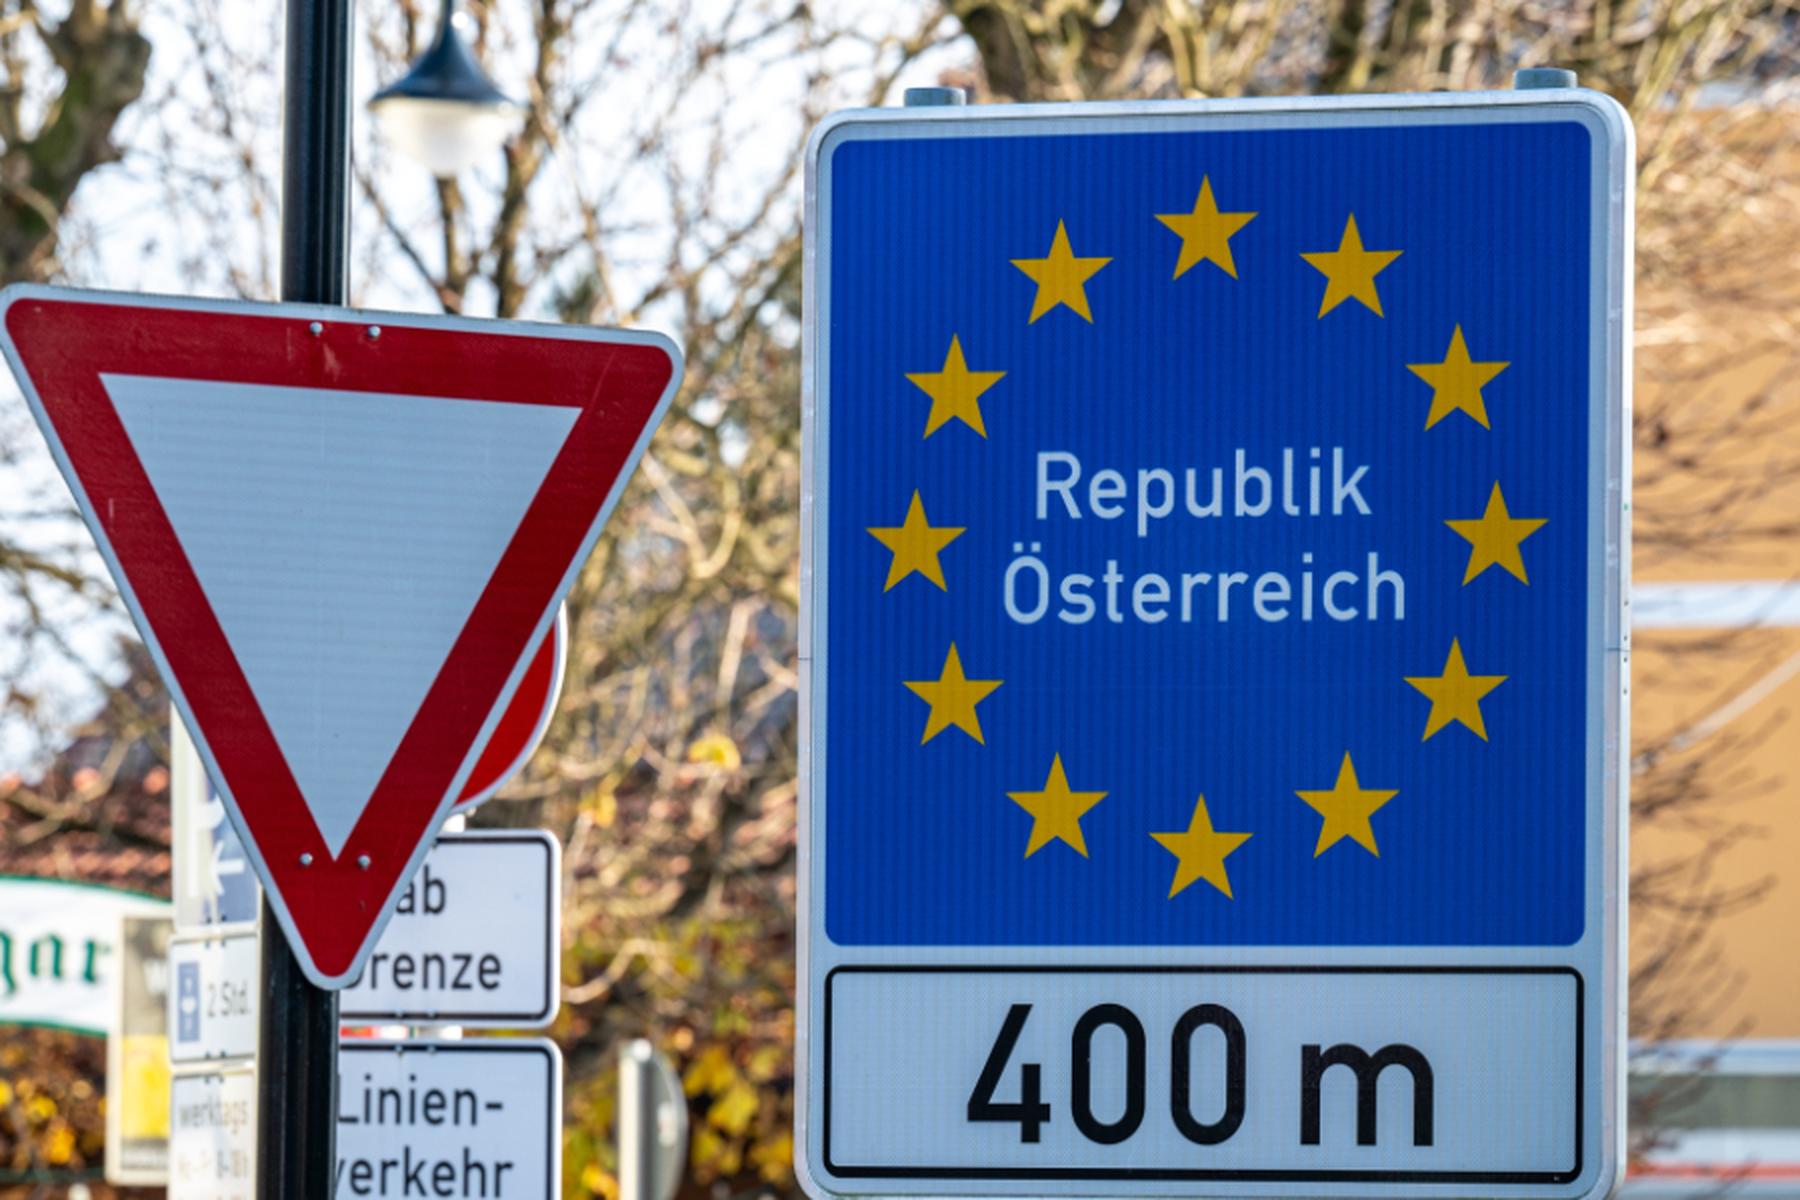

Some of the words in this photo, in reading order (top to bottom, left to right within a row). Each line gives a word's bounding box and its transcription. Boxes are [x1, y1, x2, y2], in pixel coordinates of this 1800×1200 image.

[1036, 447, 1373, 538] Republik
[1003, 541, 1406, 625] Österreich
[395, 864, 447, 915] ab
[337, 1072, 503, 1127] Linien-
[966, 1002, 1247, 1146] 400
[1299, 1042, 1435, 1148] m
